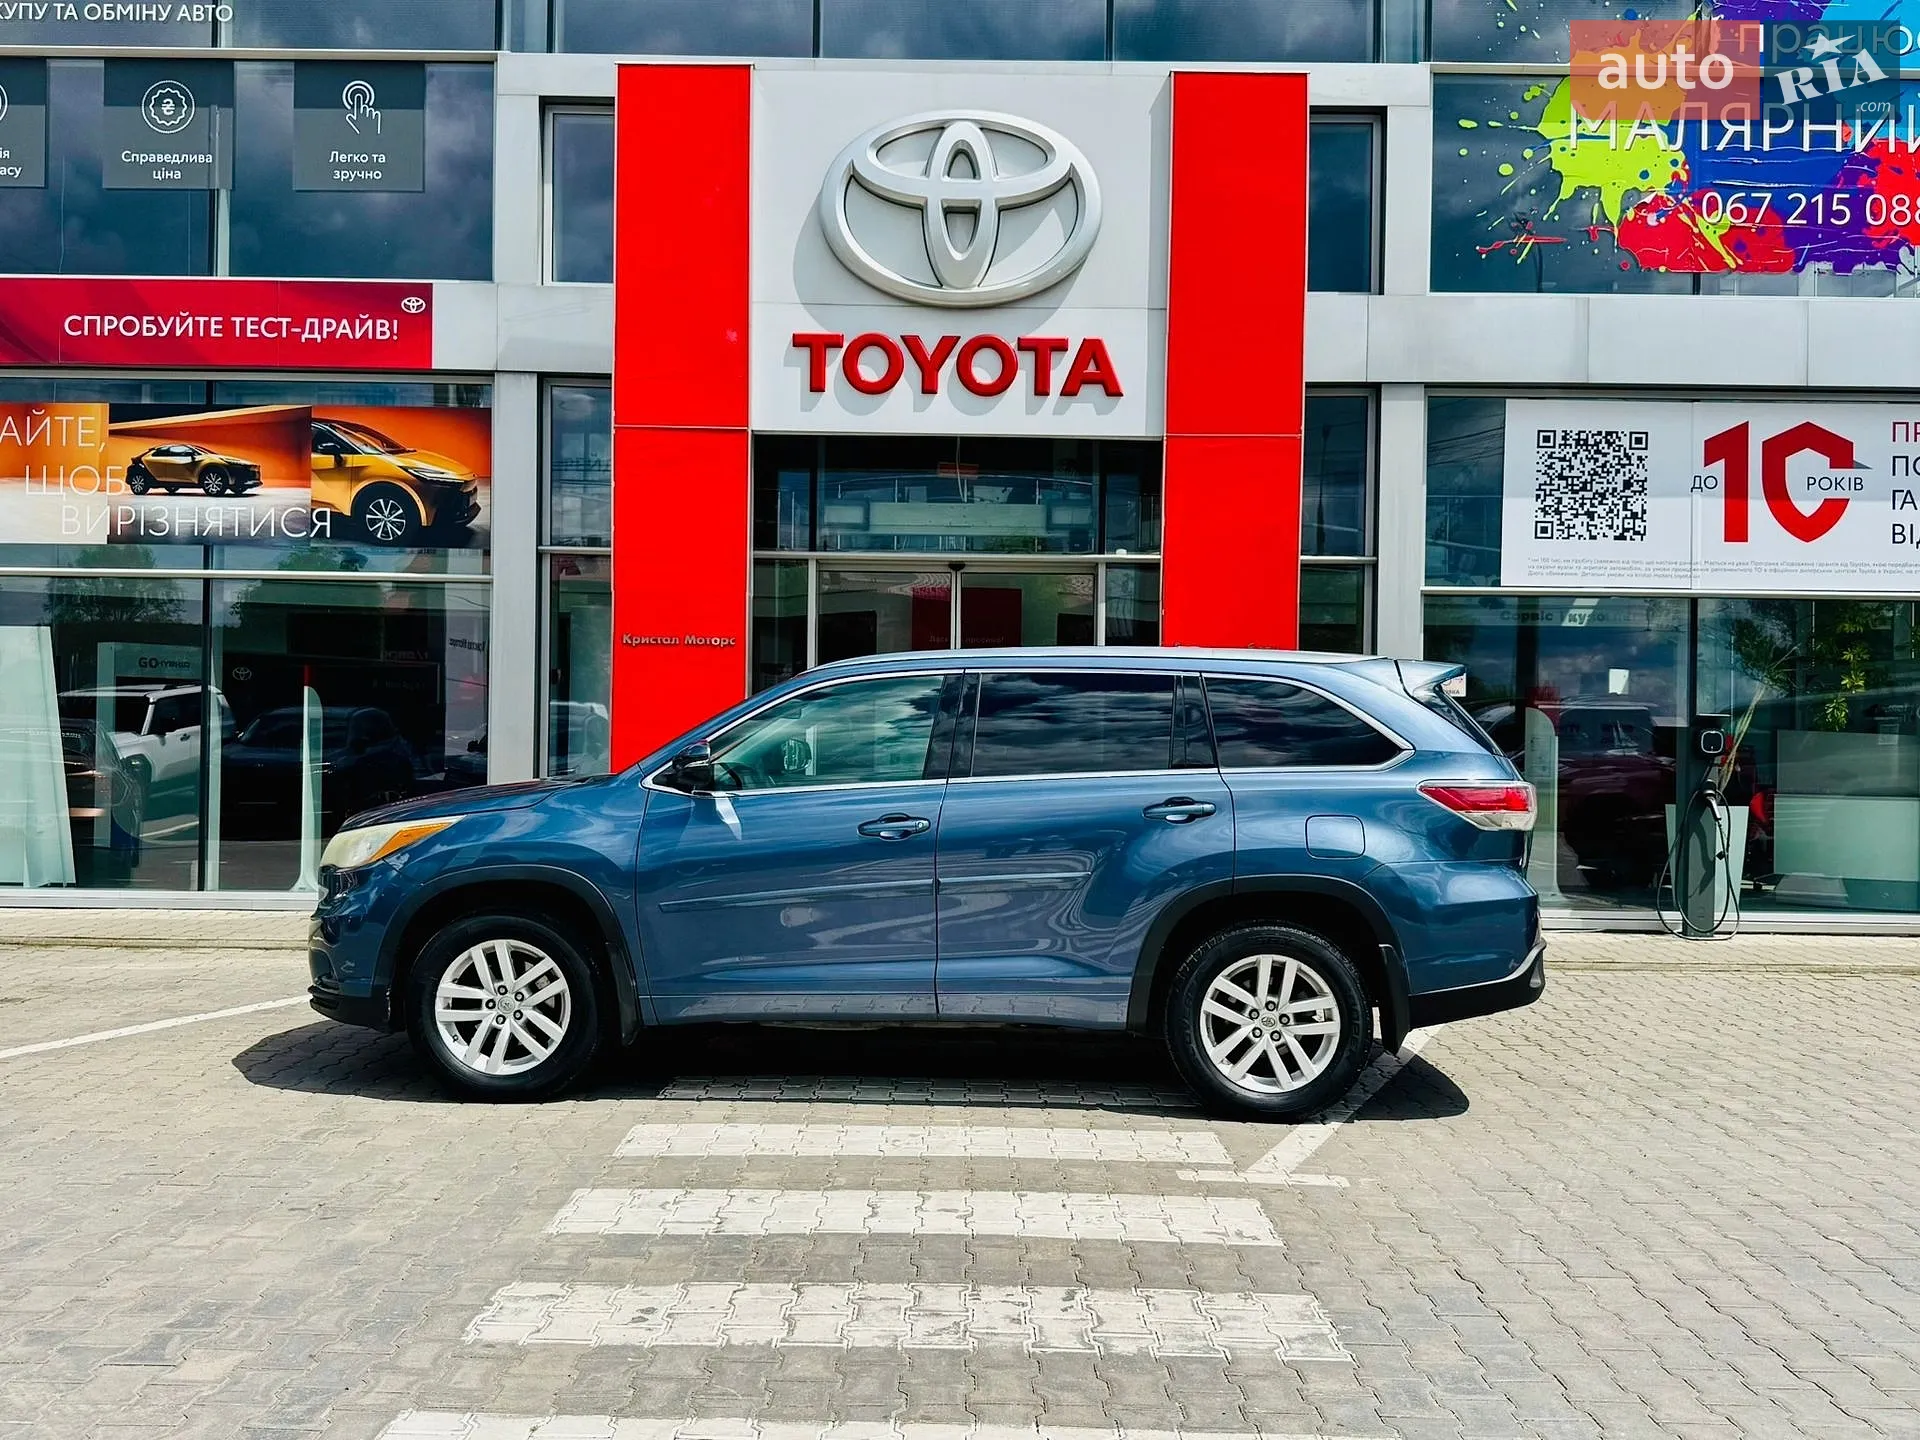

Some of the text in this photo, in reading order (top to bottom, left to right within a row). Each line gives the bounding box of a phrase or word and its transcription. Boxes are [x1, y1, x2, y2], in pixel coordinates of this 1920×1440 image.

[53, 3, 79, 21] ТА
[84, 3, 172, 22] ОБМІНУ
[177, 4, 233, 22] АВТО
[1740, 23, 1920, 64] працю
[121, 150, 213, 166] Справедлива
[329, 151, 386, 165] Легко та
[152, 168, 182, 182] ціна
[333, 169, 382, 182] зручно
[1702, 191, 1920, 226] 067 215 08
[63, 312, 399, 343] СПРОБУЙТЕ ТЕСТ-ДРАЙВ!
[792, 332, 1124, 397] TOYOTA
[0, 409, 106, 452] АЙТЕ,
[25, 465, 126, 501] ЩОБ
[1690, 475, 1718, 492] ДО
[1807, 476, 1864, 491] РОКІВ
[1892, 489, 1918, 511] ГА
[62, 504, 332, 539] ВИРІЗНЯТИСЯ
[1892, 523, 1920, 549] ВІ
[623, 633, 736, 648] Кристал Моторс
